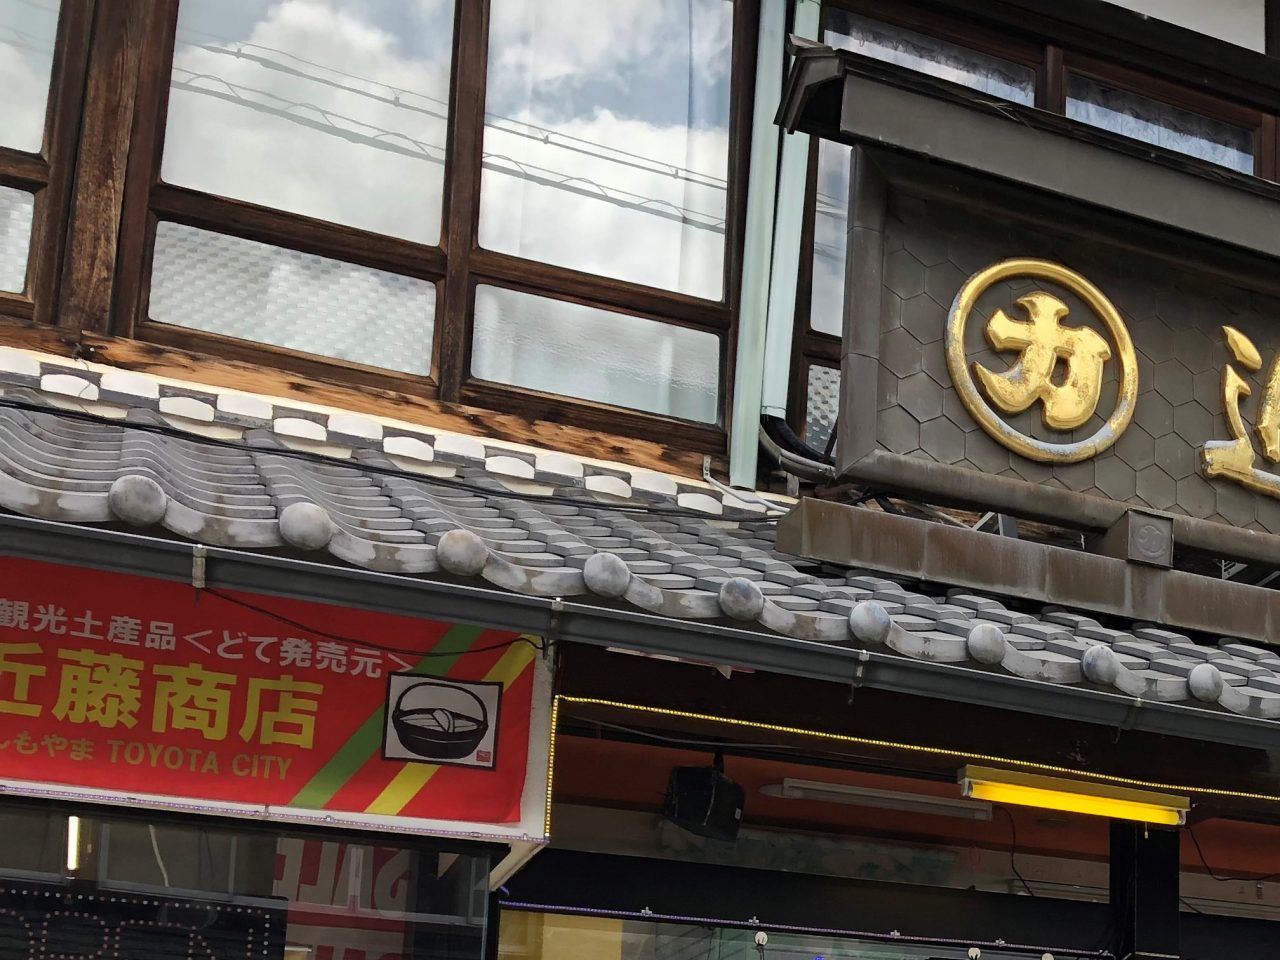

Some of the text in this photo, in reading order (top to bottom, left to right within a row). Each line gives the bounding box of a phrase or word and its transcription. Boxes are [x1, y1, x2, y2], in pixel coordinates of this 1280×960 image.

[0, 731, 293, 781] もやま TOYOTA CITY
